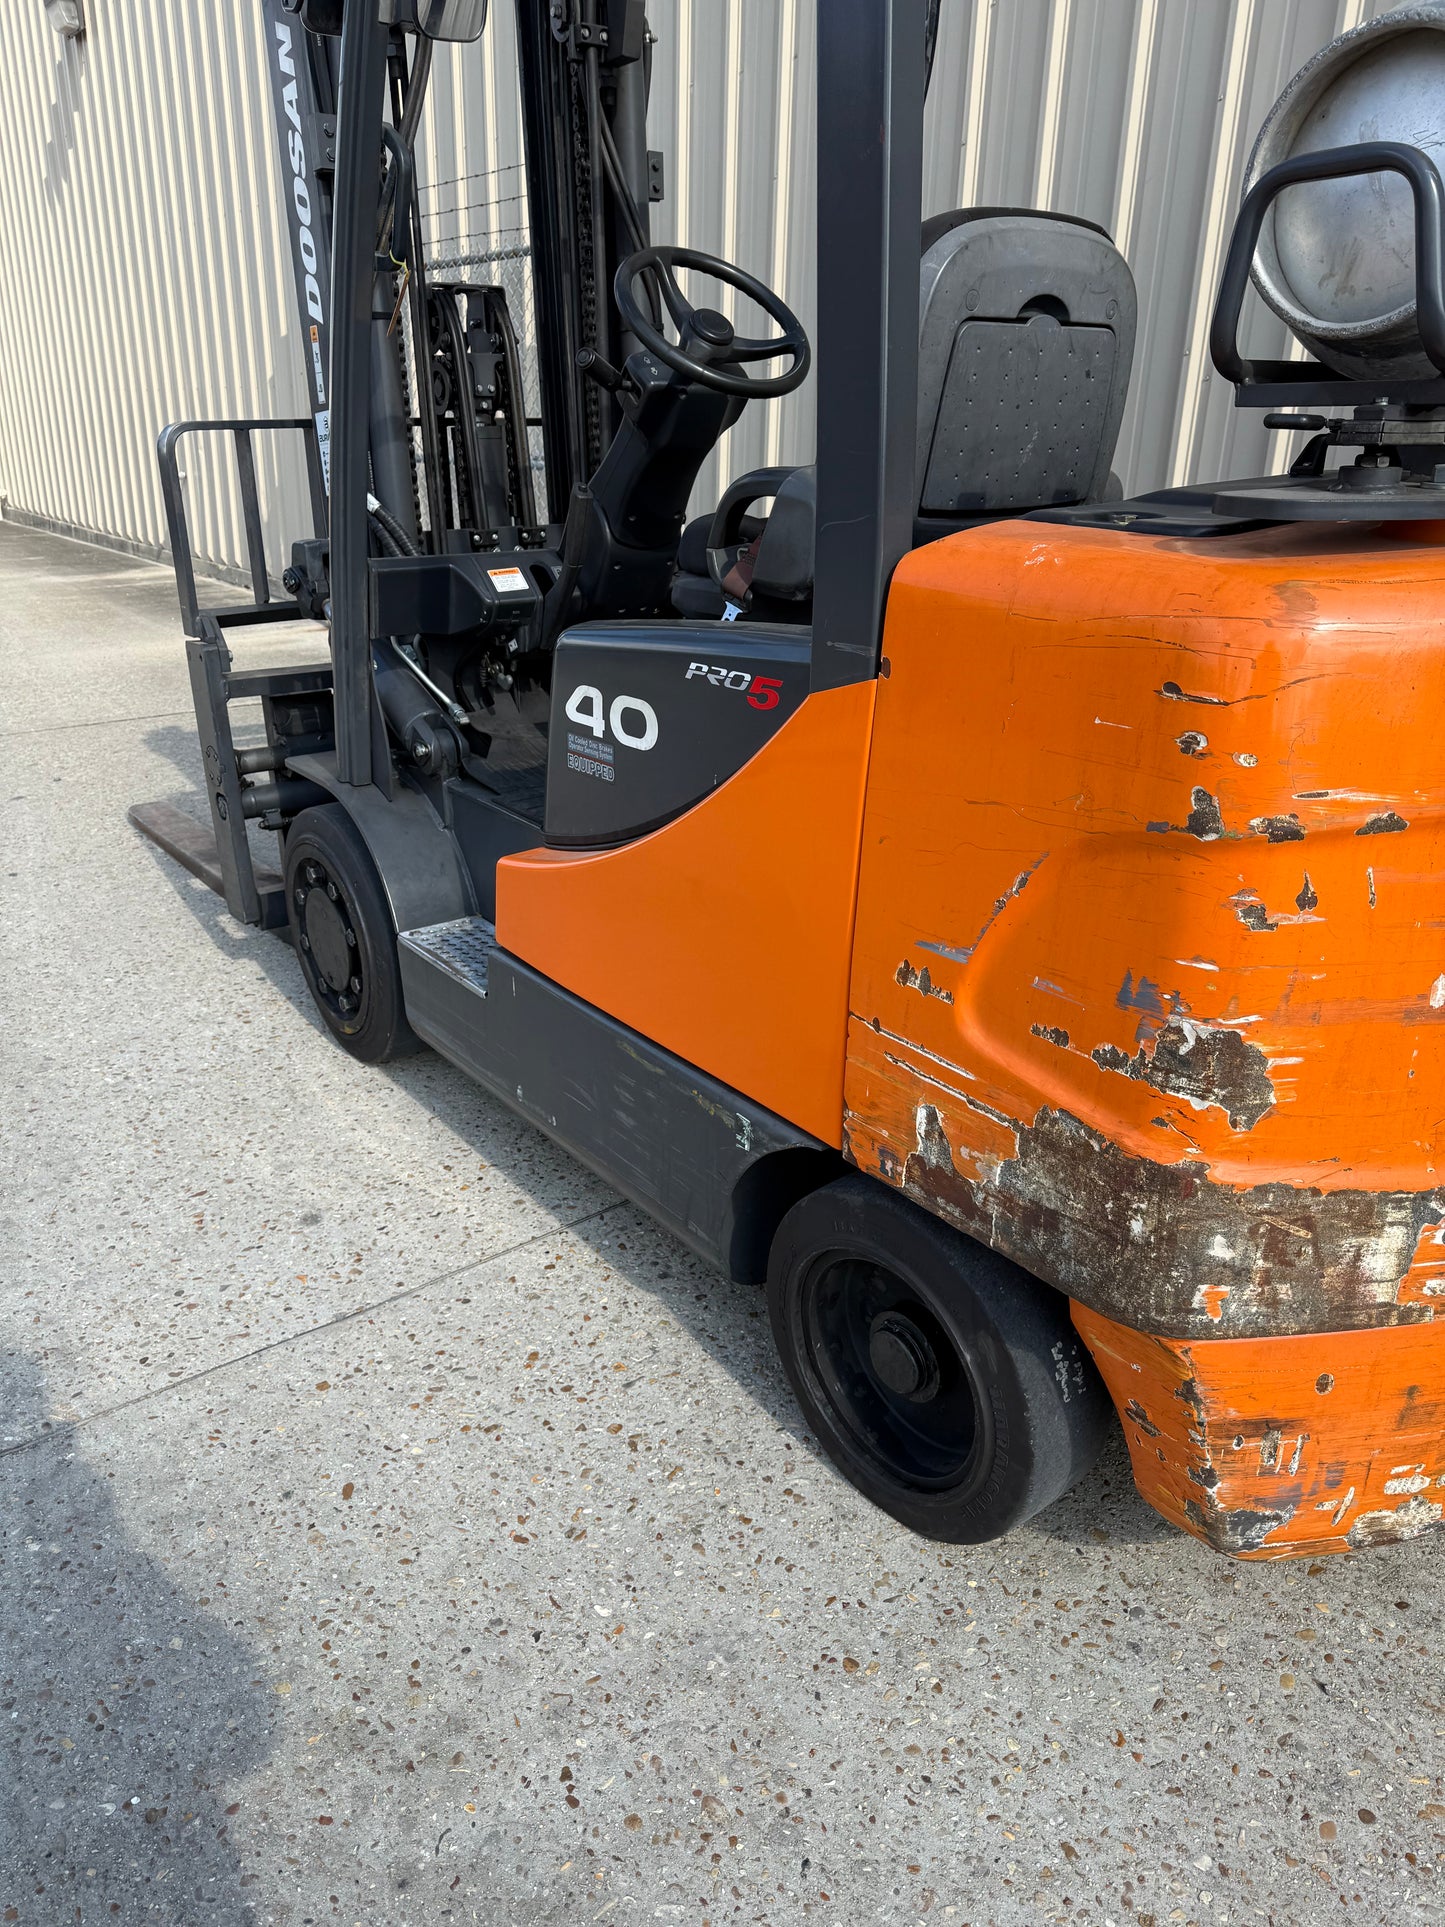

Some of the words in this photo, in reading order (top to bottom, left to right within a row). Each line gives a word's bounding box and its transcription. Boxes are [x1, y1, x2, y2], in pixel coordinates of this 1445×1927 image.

[275, 21, 324, 325] DOOSAN
[685, 661, 784, 710] PRO5
[565, 684, 659, 752] 40
[567, 753, 615, 782] EQUIPPED
[598, 743, 613, 754] Brakes
